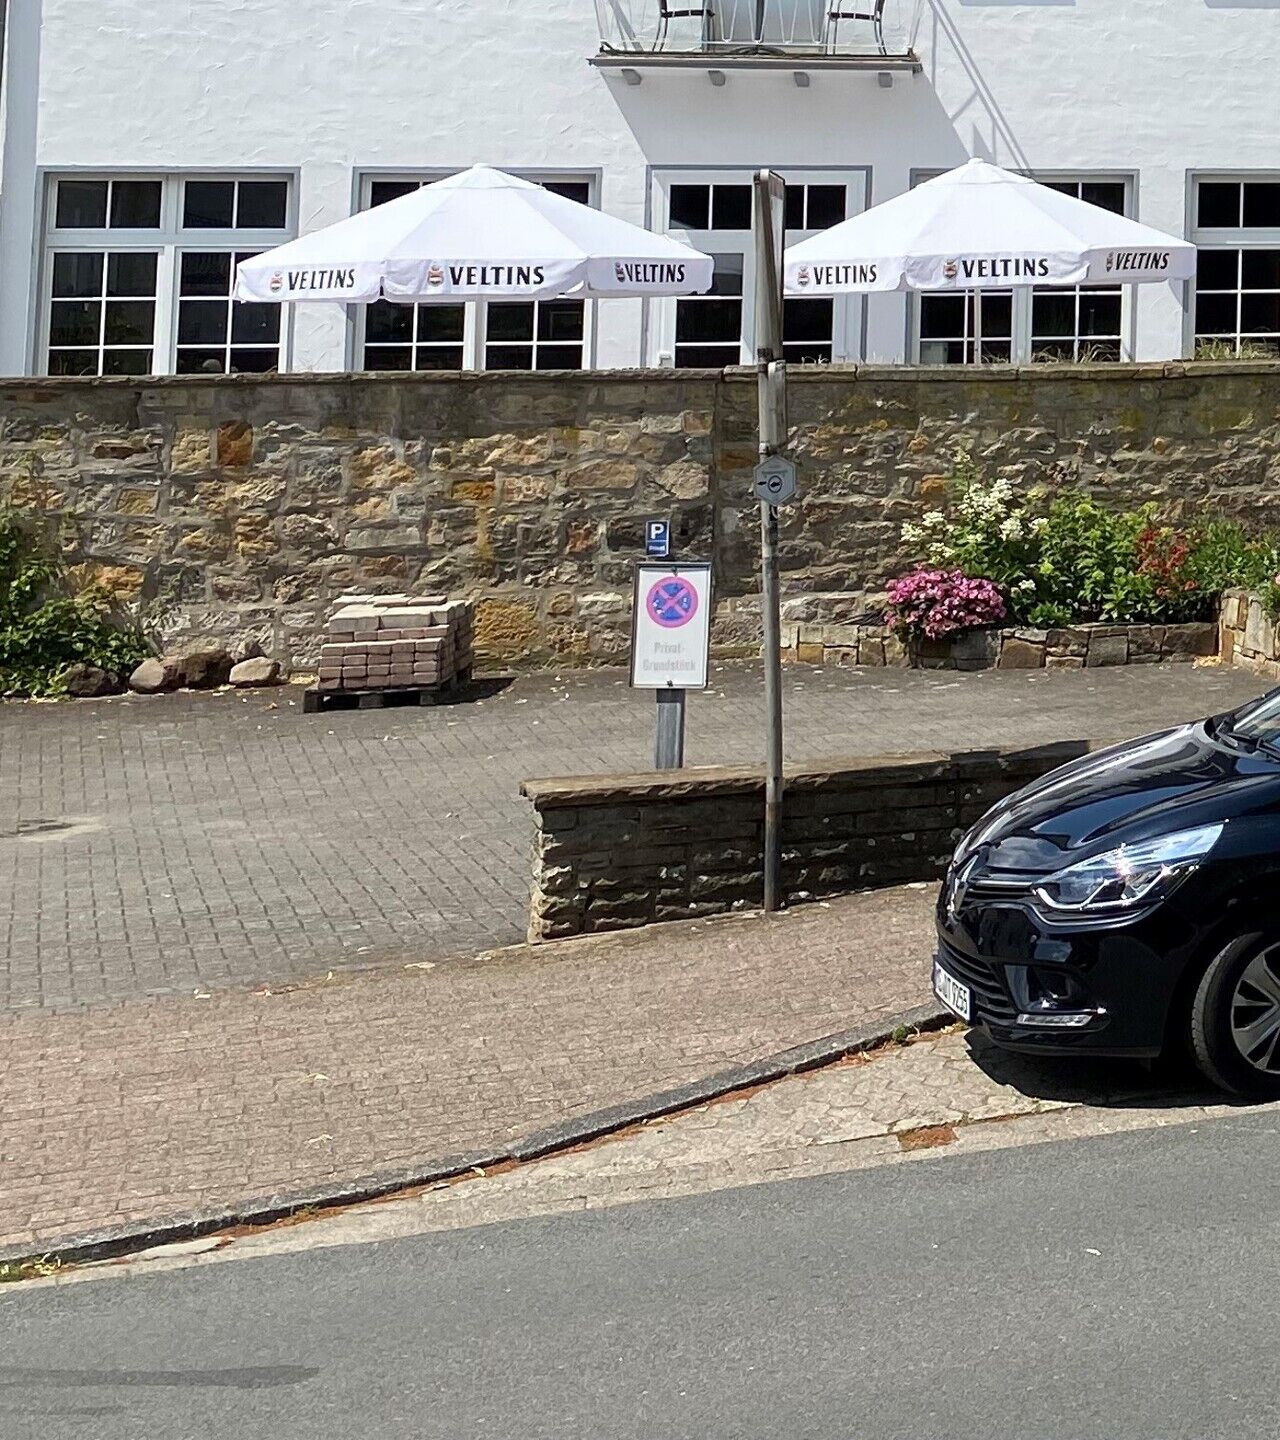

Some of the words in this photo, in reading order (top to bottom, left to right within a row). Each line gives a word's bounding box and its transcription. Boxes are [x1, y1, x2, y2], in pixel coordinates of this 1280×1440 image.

[961, 258, 1050, 278] VELTINS
[1114, 252, 1171, 271] VELTINS
[287, 267, 356, 291] VELTINS
[449, 265, 545, 286] VELTINS
[622, 262, 686, 284] VELTINS
[812, 263, 878, 285] VELTINS
[650, 523, 665, 540] P
